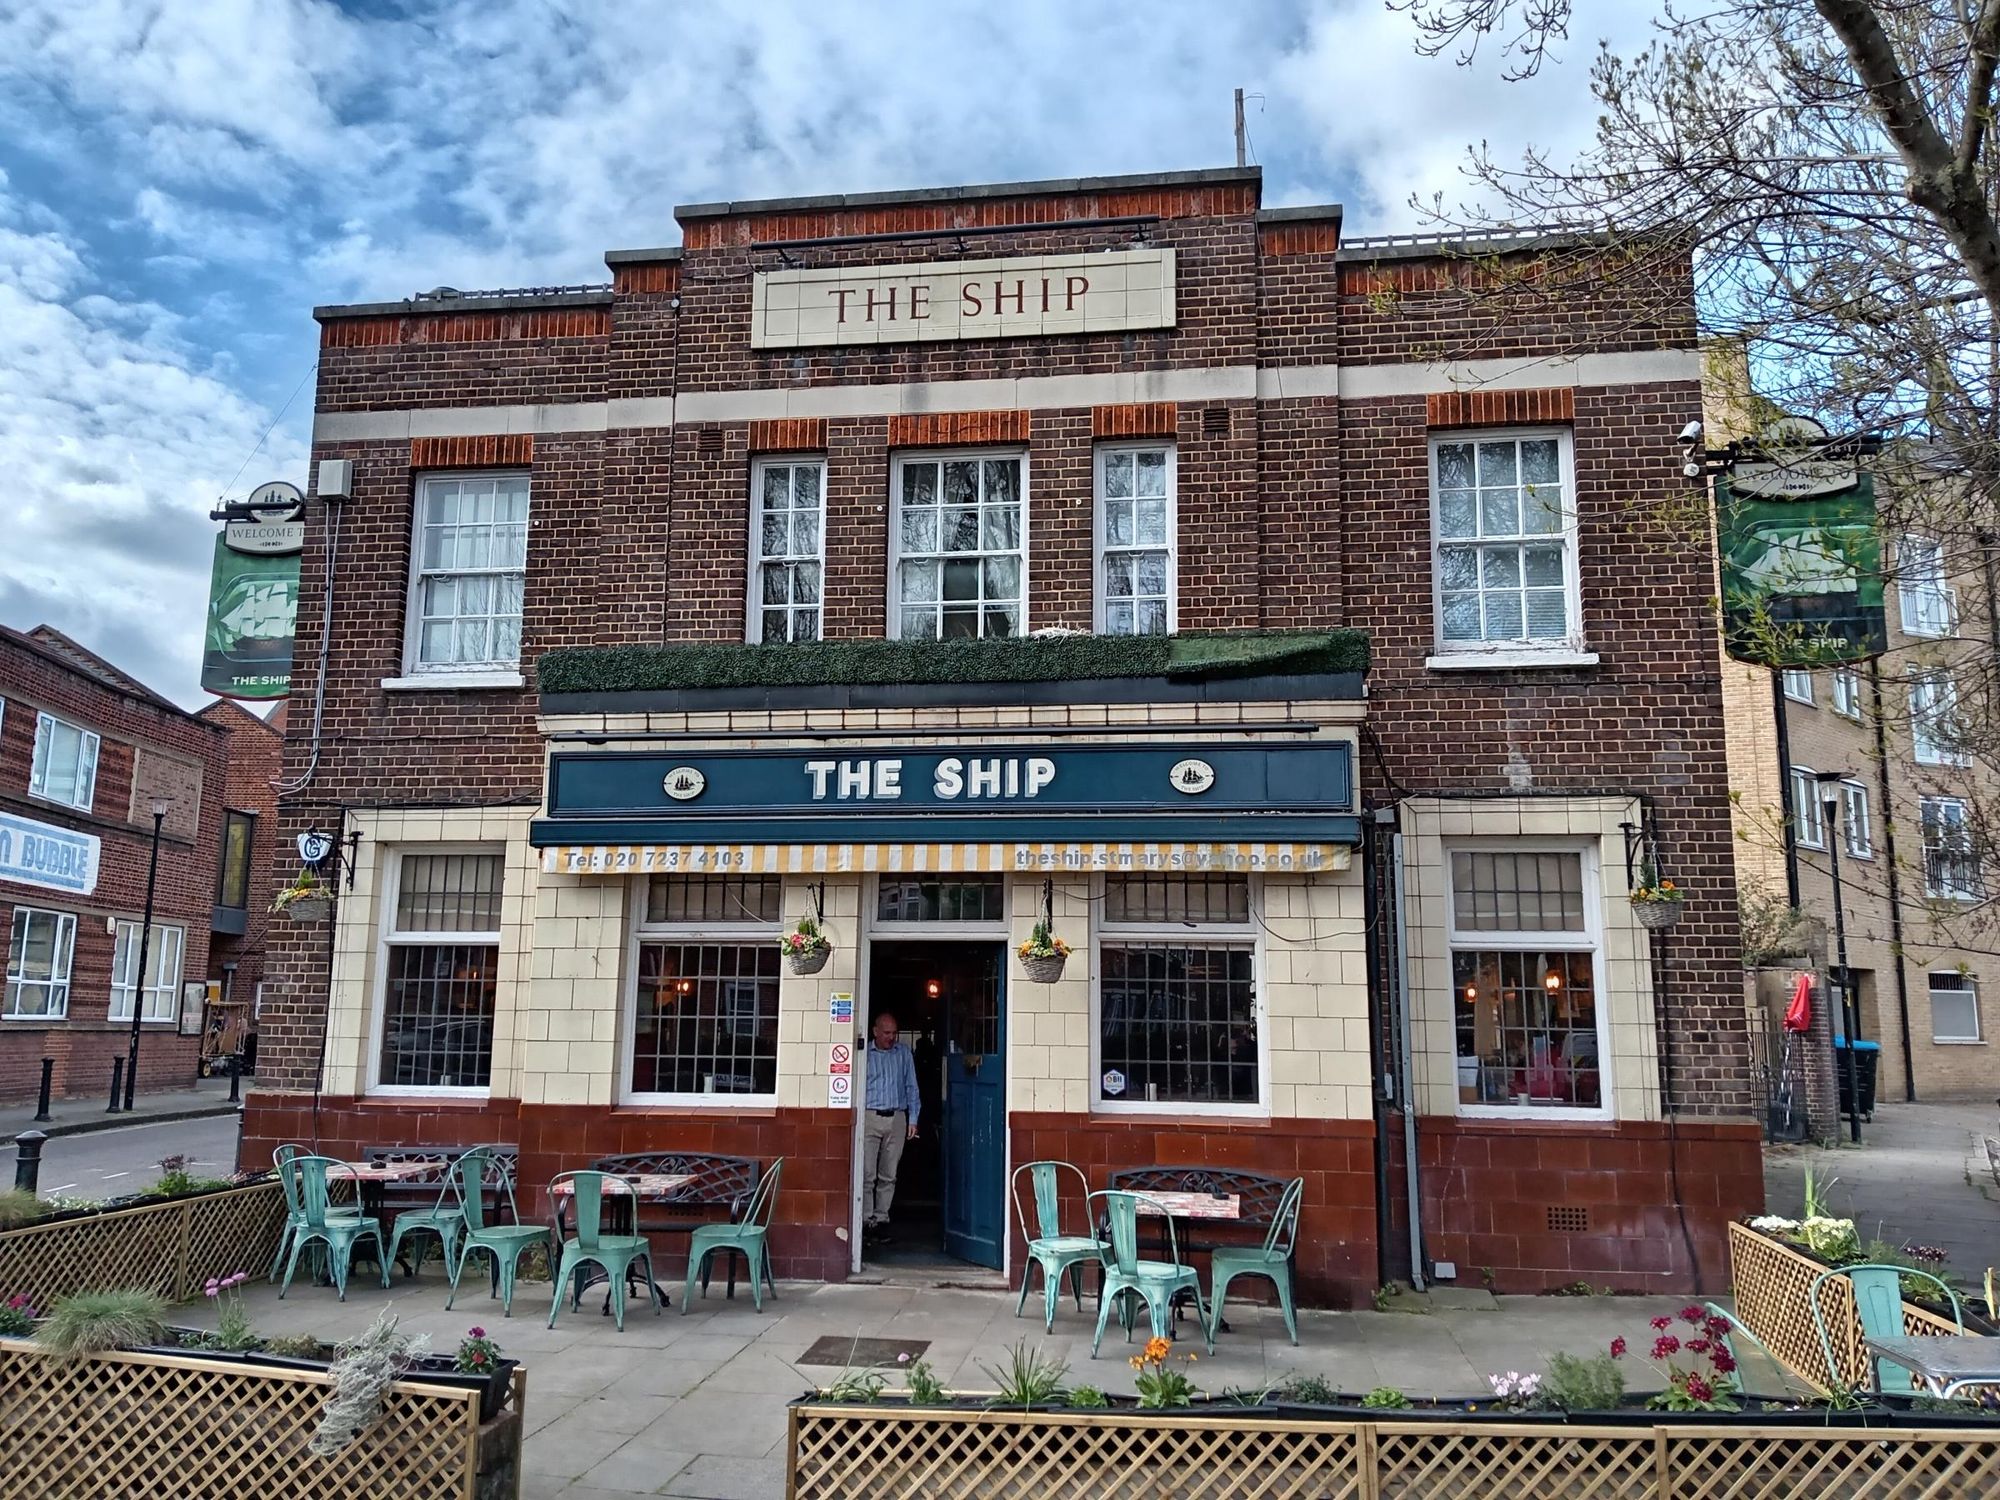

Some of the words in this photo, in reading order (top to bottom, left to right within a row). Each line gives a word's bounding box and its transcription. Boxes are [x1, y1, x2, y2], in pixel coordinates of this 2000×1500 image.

[828, 285, 931, 323] THE
[962, 276, 1090, 317] SHIP
[232, 527, 294, 539] WELCOME
[231, 676, 258, 686] THE
[261, 675, 292, 685] SHIP
[804, 760, 902, 800] THE
[933, 757, 1056, 800] SHIP
[21, 835, 89, 880] BUBBLE
[564, 852, 598, 867] Tel:
[604, 852, 638, 867] 020
[646, 851, 692, 866] 7237
[698, 851, 745, 866] 4103
[1016, 850, 1327, 868] theship.stmarys@yahoo.co.uk
